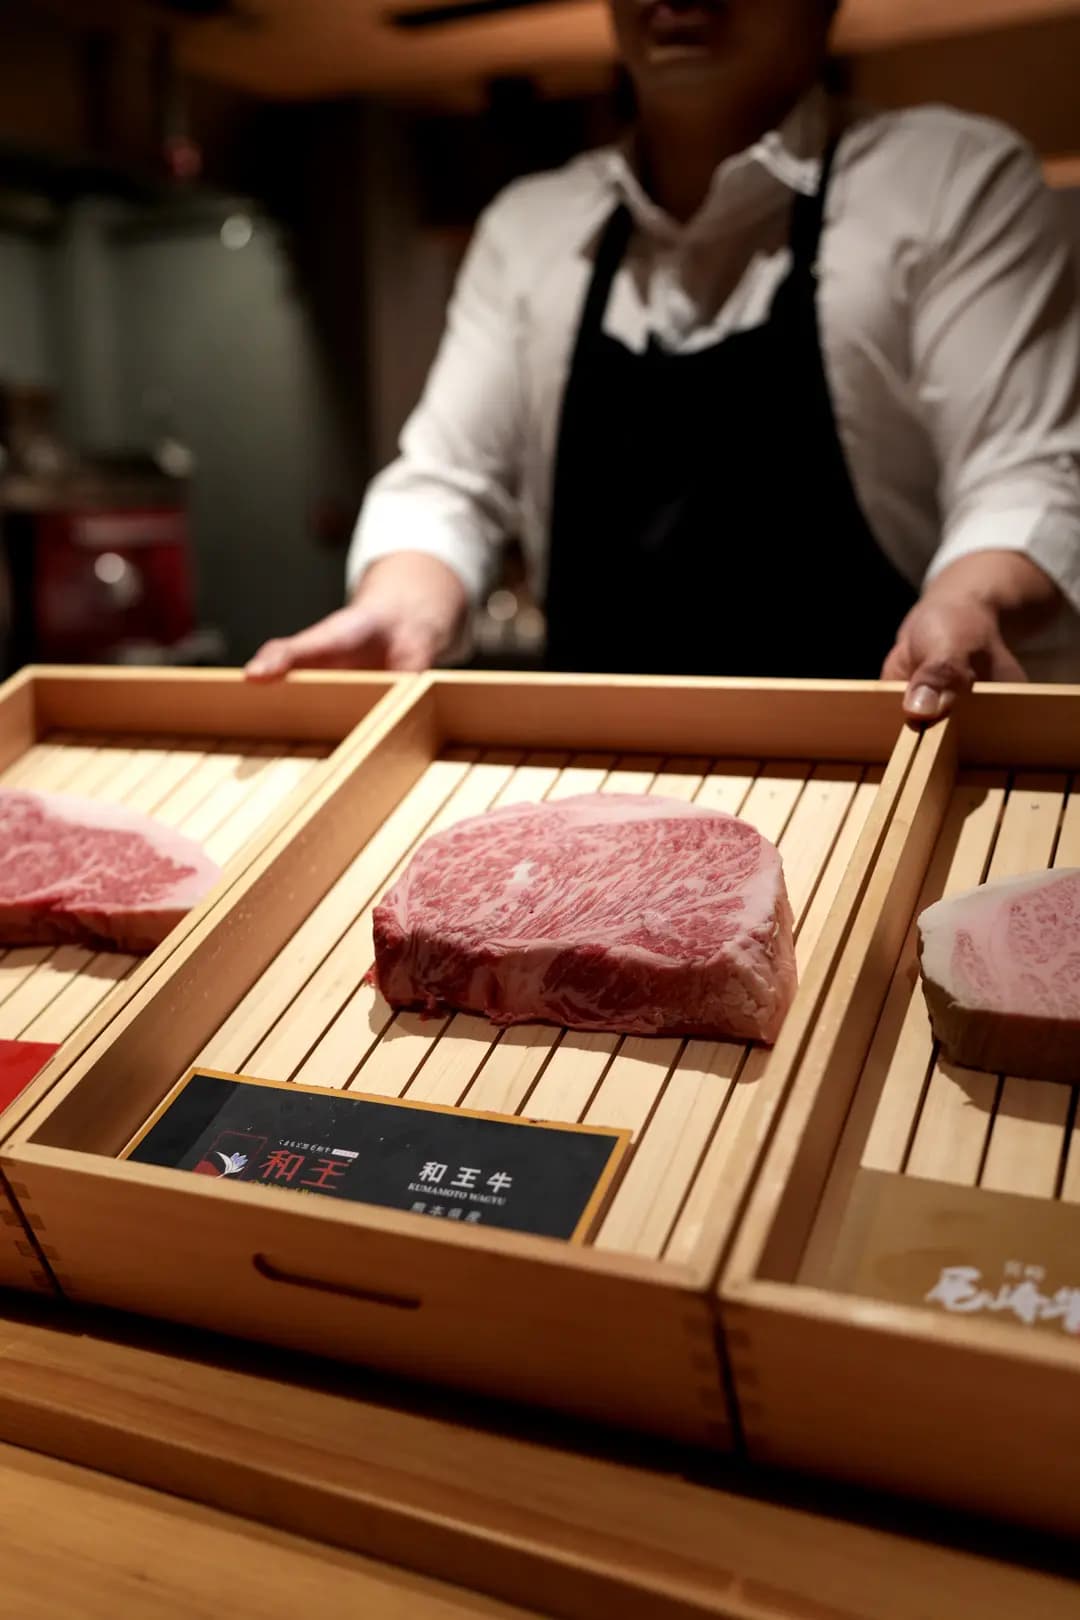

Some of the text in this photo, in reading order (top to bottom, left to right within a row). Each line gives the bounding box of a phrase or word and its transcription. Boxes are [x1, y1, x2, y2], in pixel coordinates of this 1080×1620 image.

[258, 1149, 350, 1189] 和王
[418, 1161, 512, 1193] 和王牛
[407, 1183, 468, 1200] KUMAMOTO
